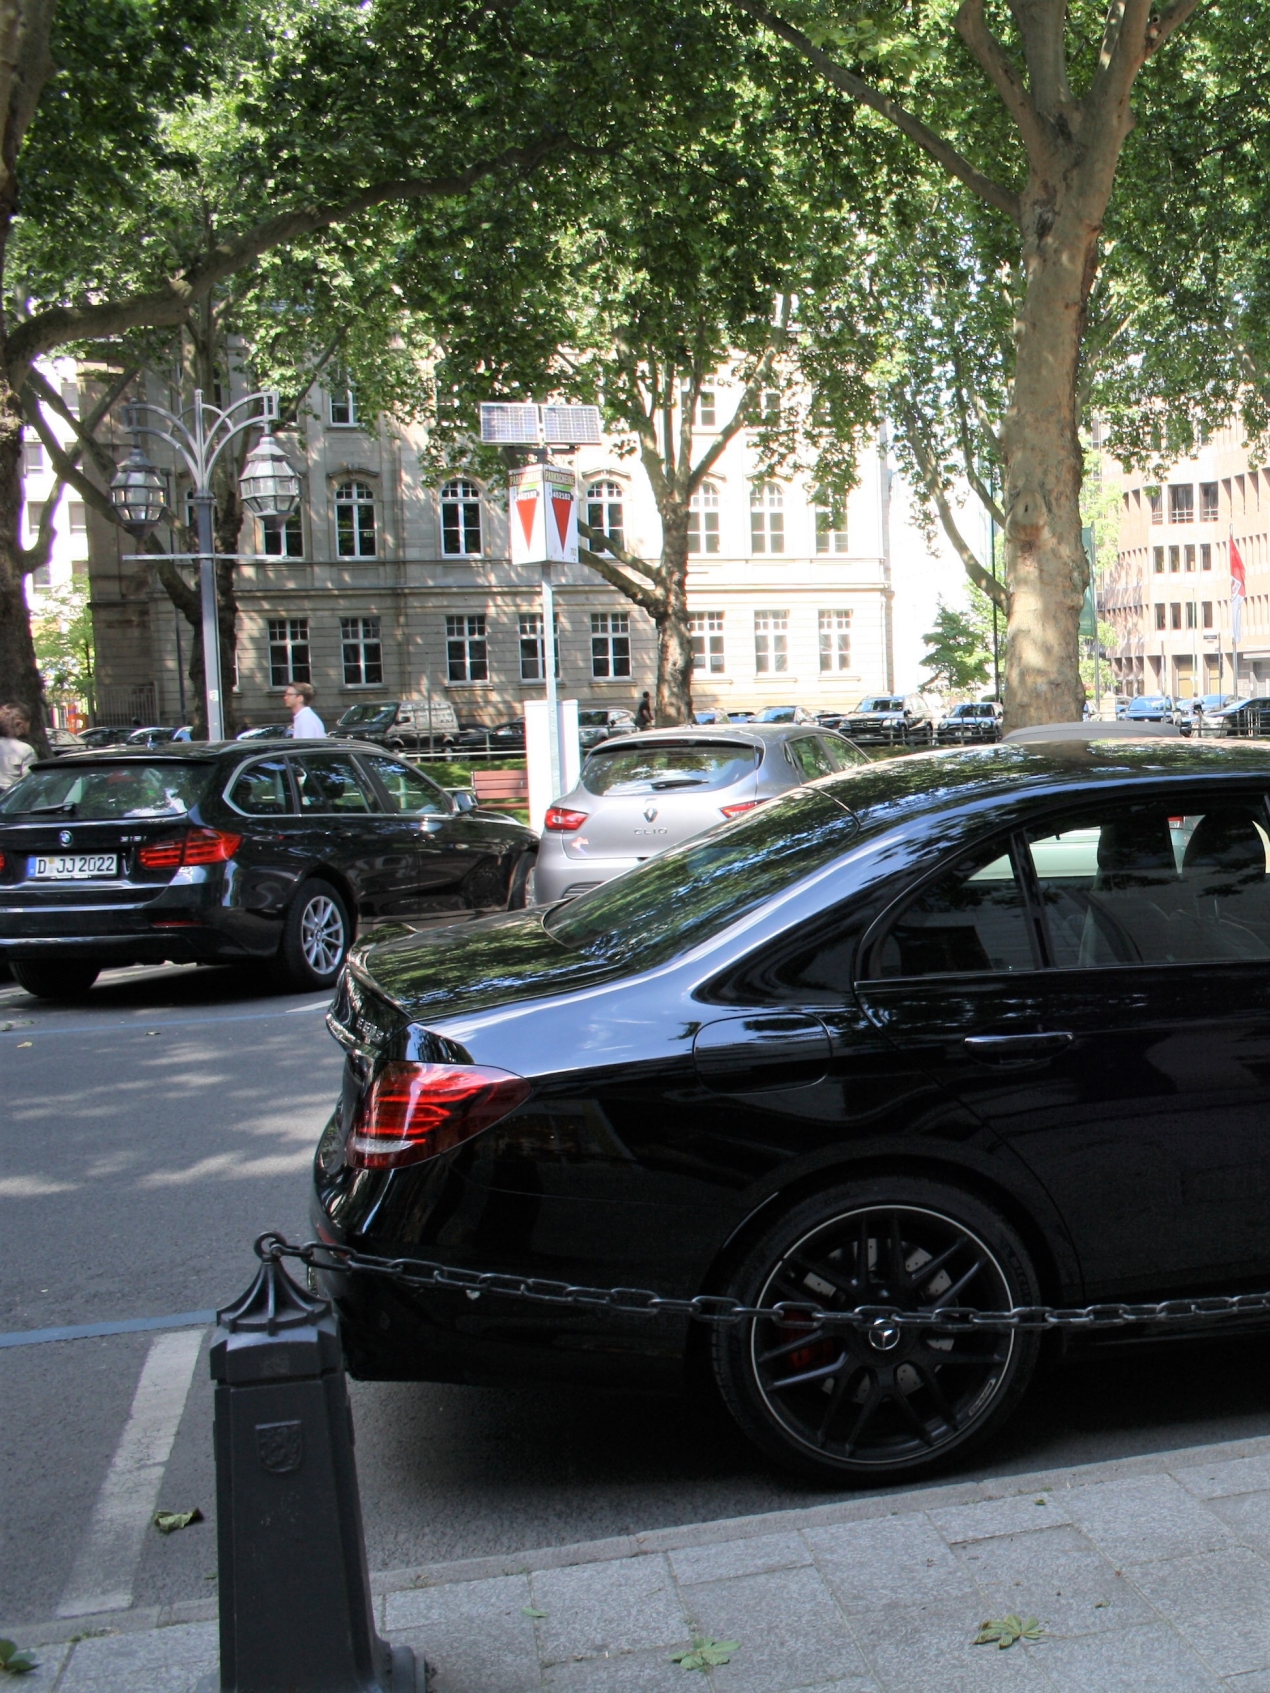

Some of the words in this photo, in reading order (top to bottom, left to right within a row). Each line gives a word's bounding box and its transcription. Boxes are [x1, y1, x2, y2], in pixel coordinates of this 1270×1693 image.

[545, 471, 575, 486] PARKSCHEINE
[634, 827, 668, 835] CLIO
[37, 858, 48, 875] D
[56, 857, 76, 874] JJ
[78, 855, 115, 873] 2022
